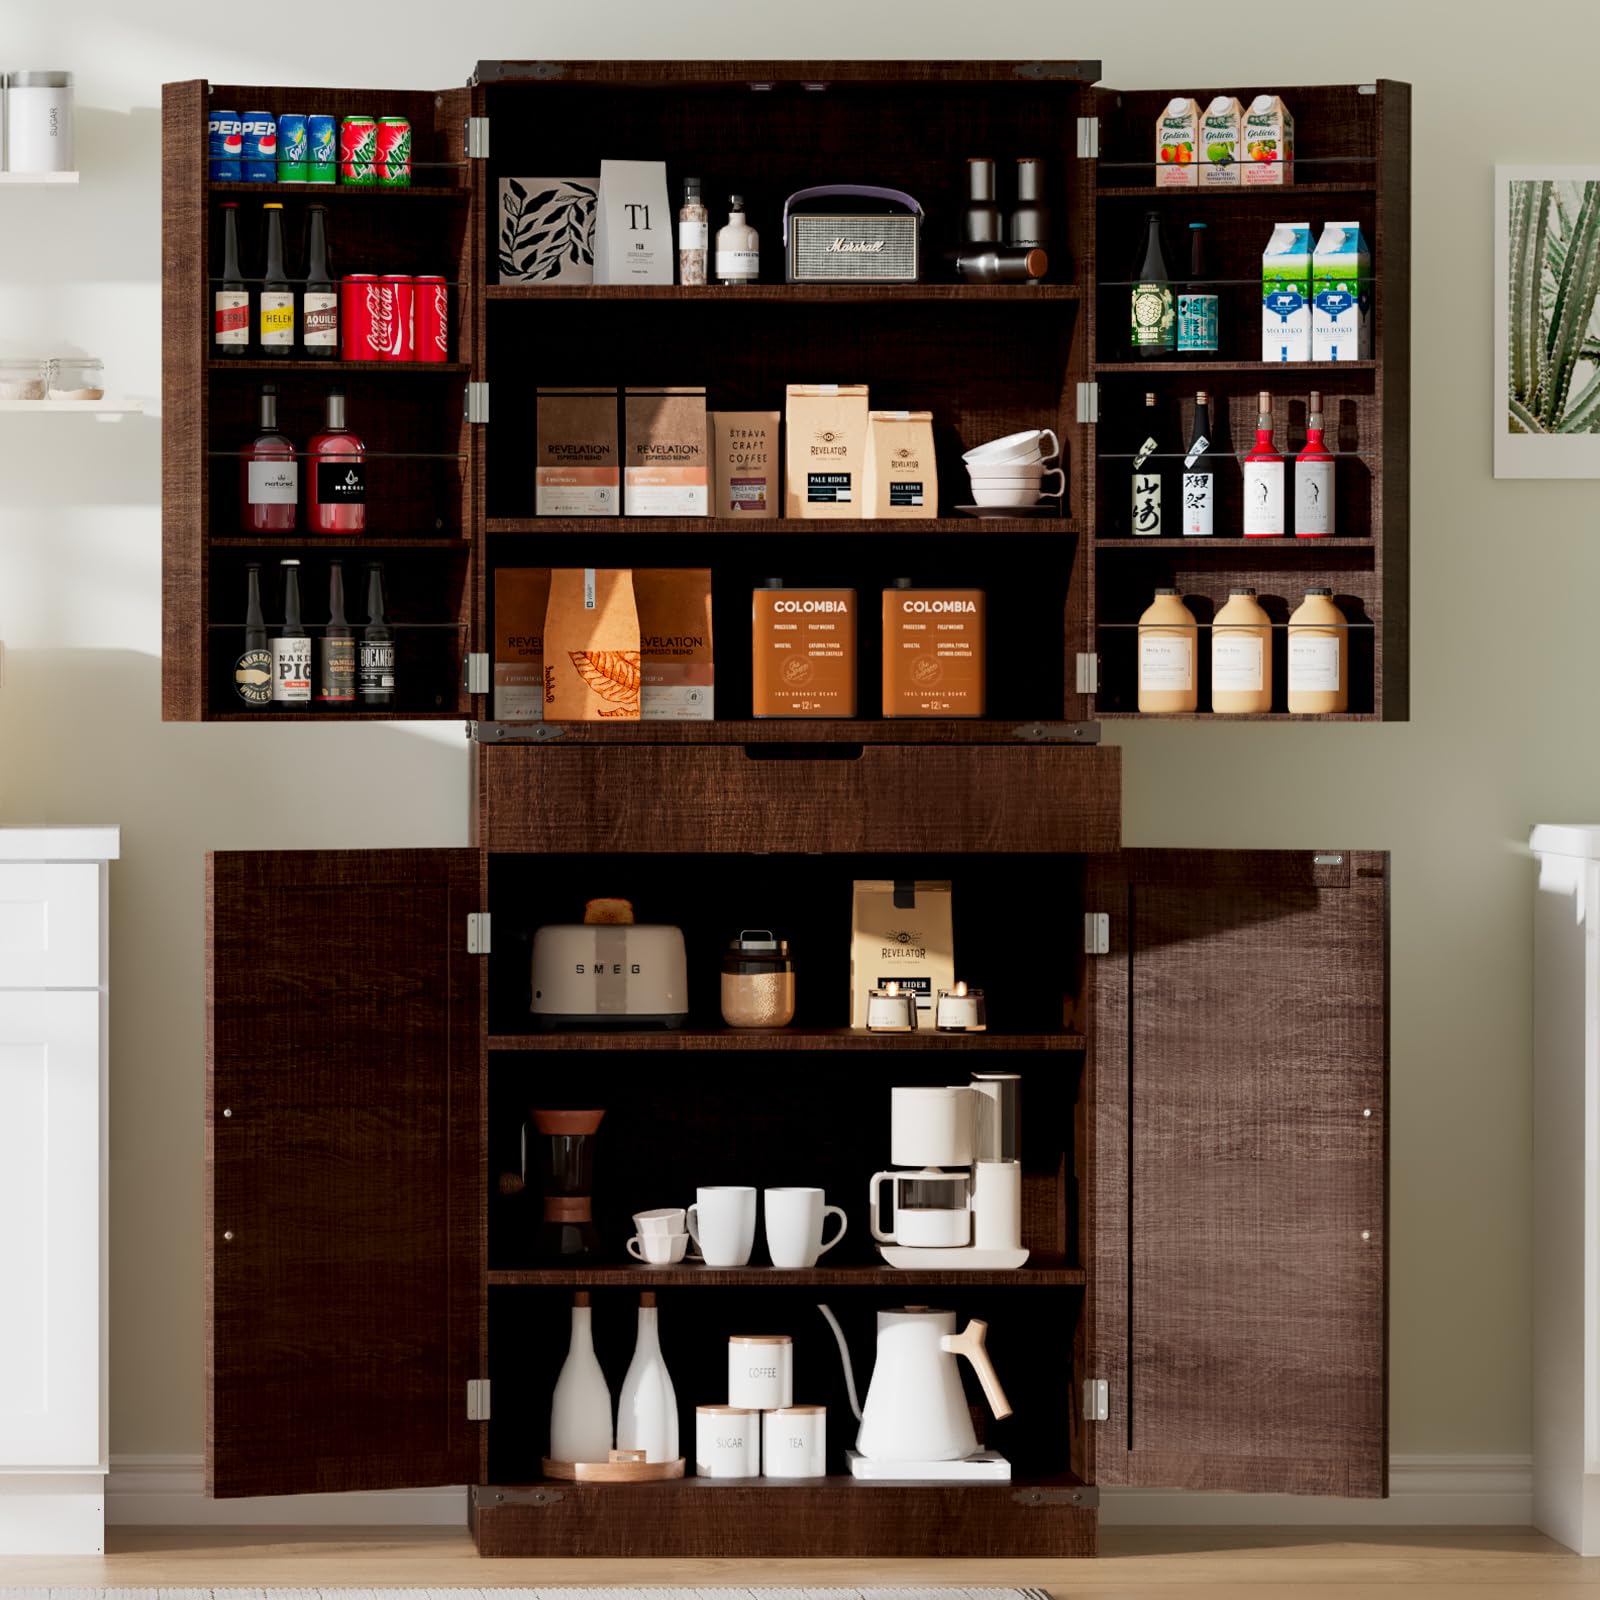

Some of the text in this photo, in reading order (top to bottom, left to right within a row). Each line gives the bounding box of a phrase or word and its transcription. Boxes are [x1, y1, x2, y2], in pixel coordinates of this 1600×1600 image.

[49, 107, 58, 137] SUGAR
[208, 120, 242, 135] PEP
[242, 121, 277, 136] PEP
[624, 203, 653, 231] T1
[826, 238, 884, 253] Marshall
[729, 429, 766, 438] STRAVA
[548, 445, 610, 455] REVELATION
[636, 444, 699, 455] REVELATION
[732, 441, 764, 450] CRAFT
[811, 446, 847, 457] REVELATOR
[728, 453, 767, 463] COFFEE
[891, 460, 919, 469] REVELATOR
[774, 601, 848, 613] COLOMBIA
[903, 601, 977, 613] COLOMBIA
[508, 636, 544, 648] REVEL
[640, 636, 703, 648] EVELATION
[280, 654, 311, 662] NAKE
[881, 948, 926, 959] REVELATOR
[575, 964, 641, 974] SMEG
[902, 981, 927, 989] RIDER
[749, 1367, 777, 1378] COFFEE
[716, 1437, 743, 1448] SUGAR
[788, 1438, 804, 1449] TEA
